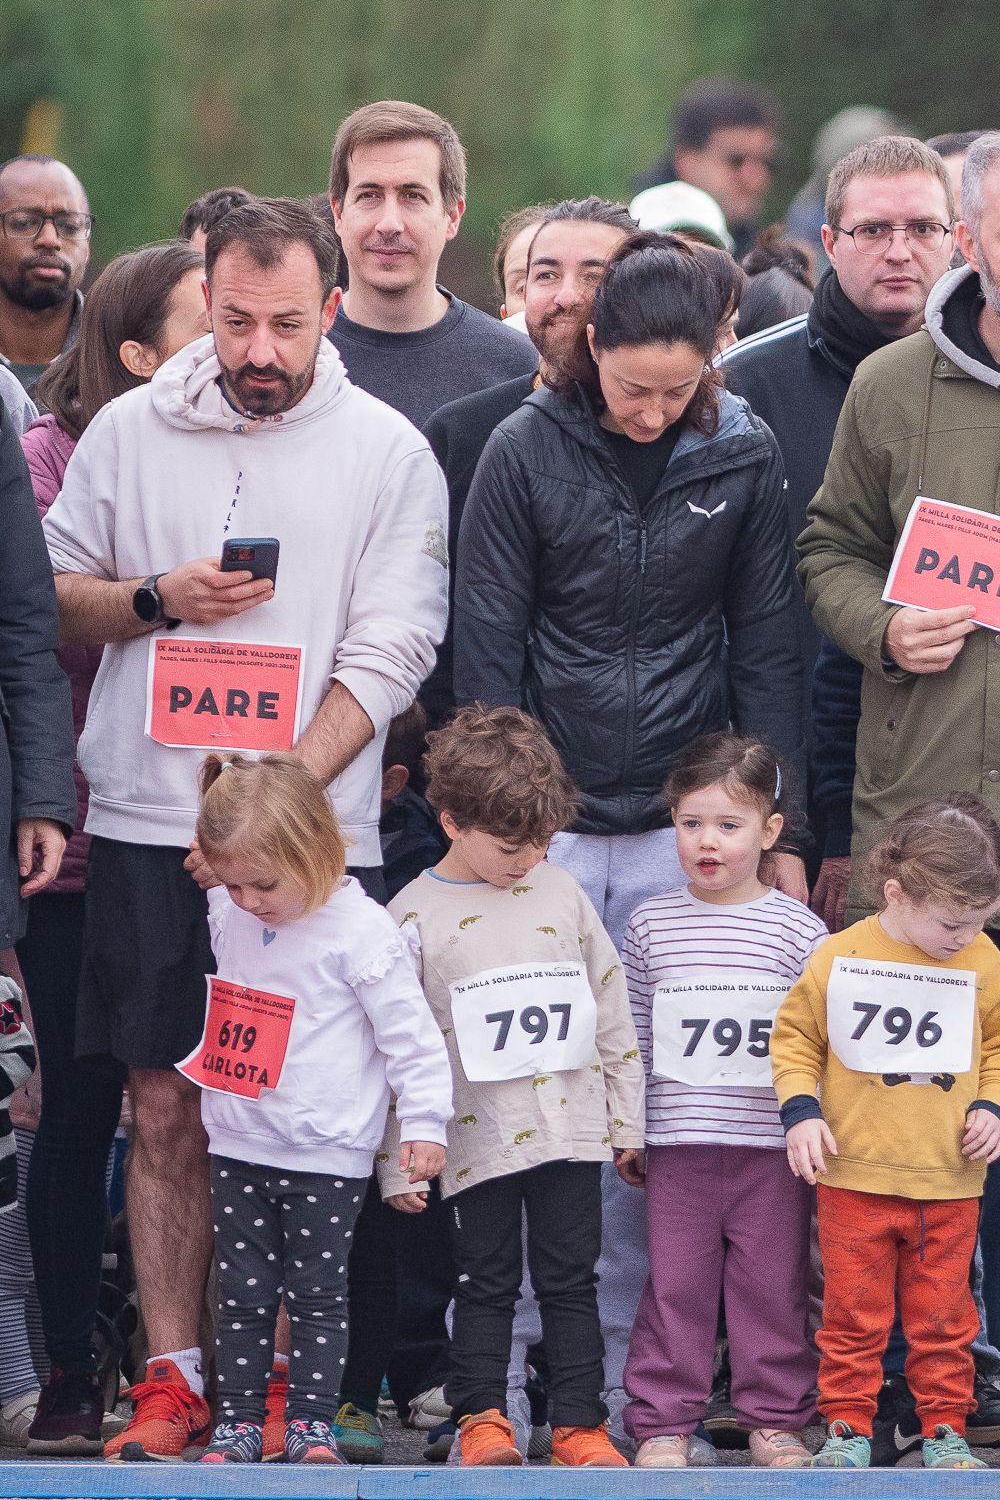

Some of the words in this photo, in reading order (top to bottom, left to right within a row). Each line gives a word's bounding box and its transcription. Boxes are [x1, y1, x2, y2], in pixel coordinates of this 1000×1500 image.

[928, 508, 949, 519] MILLA
[951, 513, 989, 530] SOLIDÀRIA
[958, 526, 971, 534] FILLS
[168, 645, 191, 653] MILLA
[194, 646, 234, 655] SOLIDÀRIA
[250, 651, 298, 660] VALLDOREIX
[169, 685, 280, 719] PARE
[467, 980, 490, 990] MILLA
[492, 972, 532, 984] SOLIDÀRIA
[672, 985, 692, 993] MILLA
[695, 983, 735, 991] SOLIDÀRIA
[850, 967, 869, 975] MILLA
[871, 969, 911, 980] SOLIDÀRIA
[926, 976, 968, 986] VALLDOREIX
[218, 1020, 257, 1053] 619
[485, 1003, 572, 1051] 797
[681, 1018, 772, 1057] 795
[850, 1001, 942, 1048] 796
[202, 1053, 268, 1085] CARLOTA
